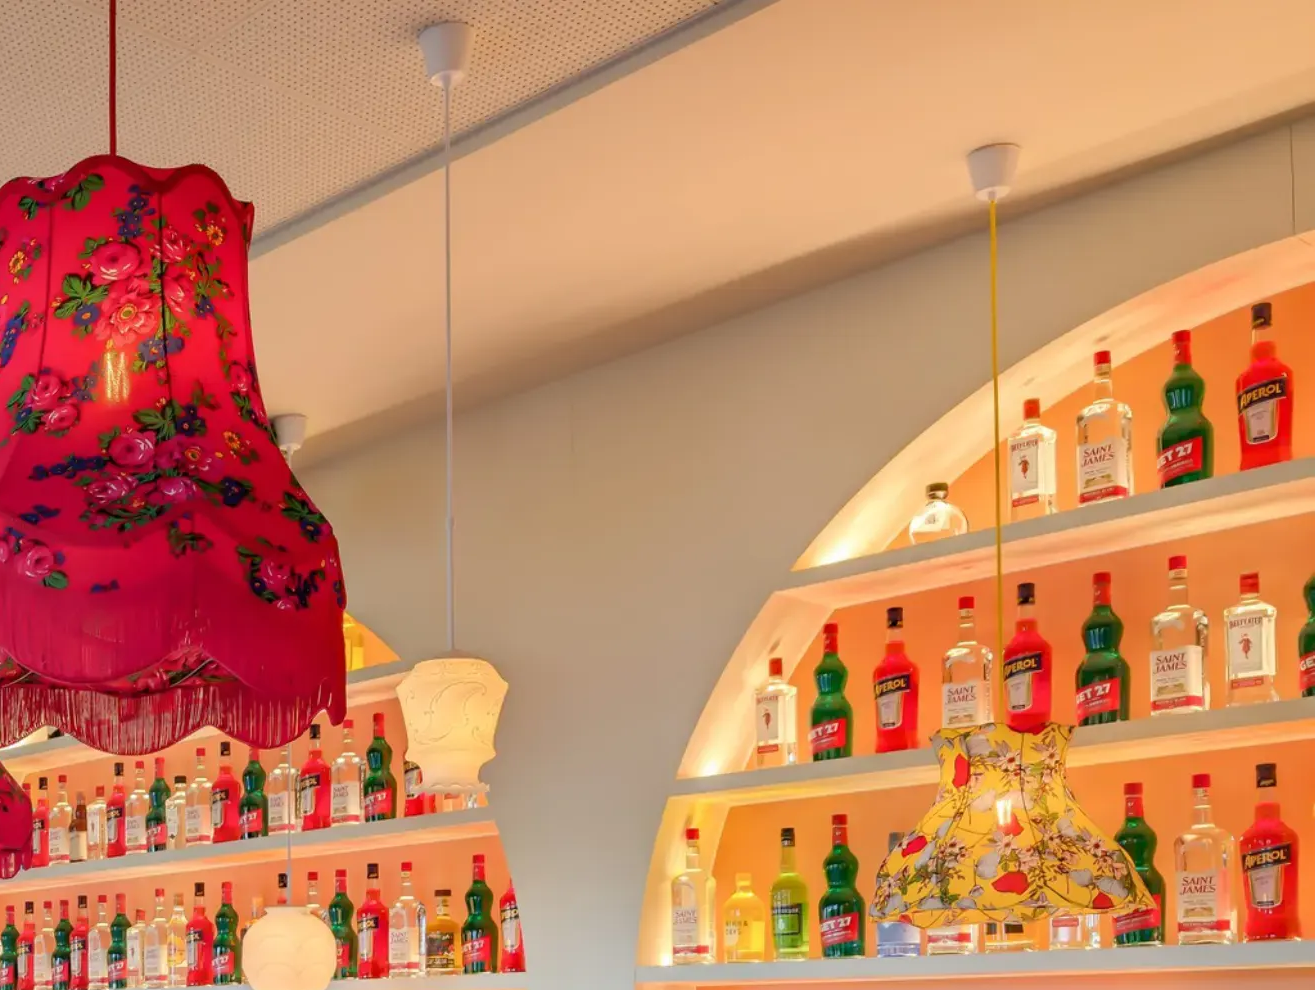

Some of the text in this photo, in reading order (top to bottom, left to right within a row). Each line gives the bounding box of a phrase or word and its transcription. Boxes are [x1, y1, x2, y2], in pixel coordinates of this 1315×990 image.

[1240, 384, 1282, 410] APEROL
[1083, 443, 1113, 458] SAINT
[1176, 442, 1193, 458] 27
[1081, 451, 1115, 468] JAMES
[1156, 652, 1186, 665] SAINT
[1153, 661, 1188, 675] JAMES
[947, 685, 976, 696] SAINT
[1095, 683, 1111, 697] 27
[945, 694, 977, 705] JAMES
[825, 722, 839, 735] 27
[1245, 848, 1287, 870] APEROL
[1182, 876, 1214, 887] SAINT
[1180, 884, 1216, 895] JAMES
